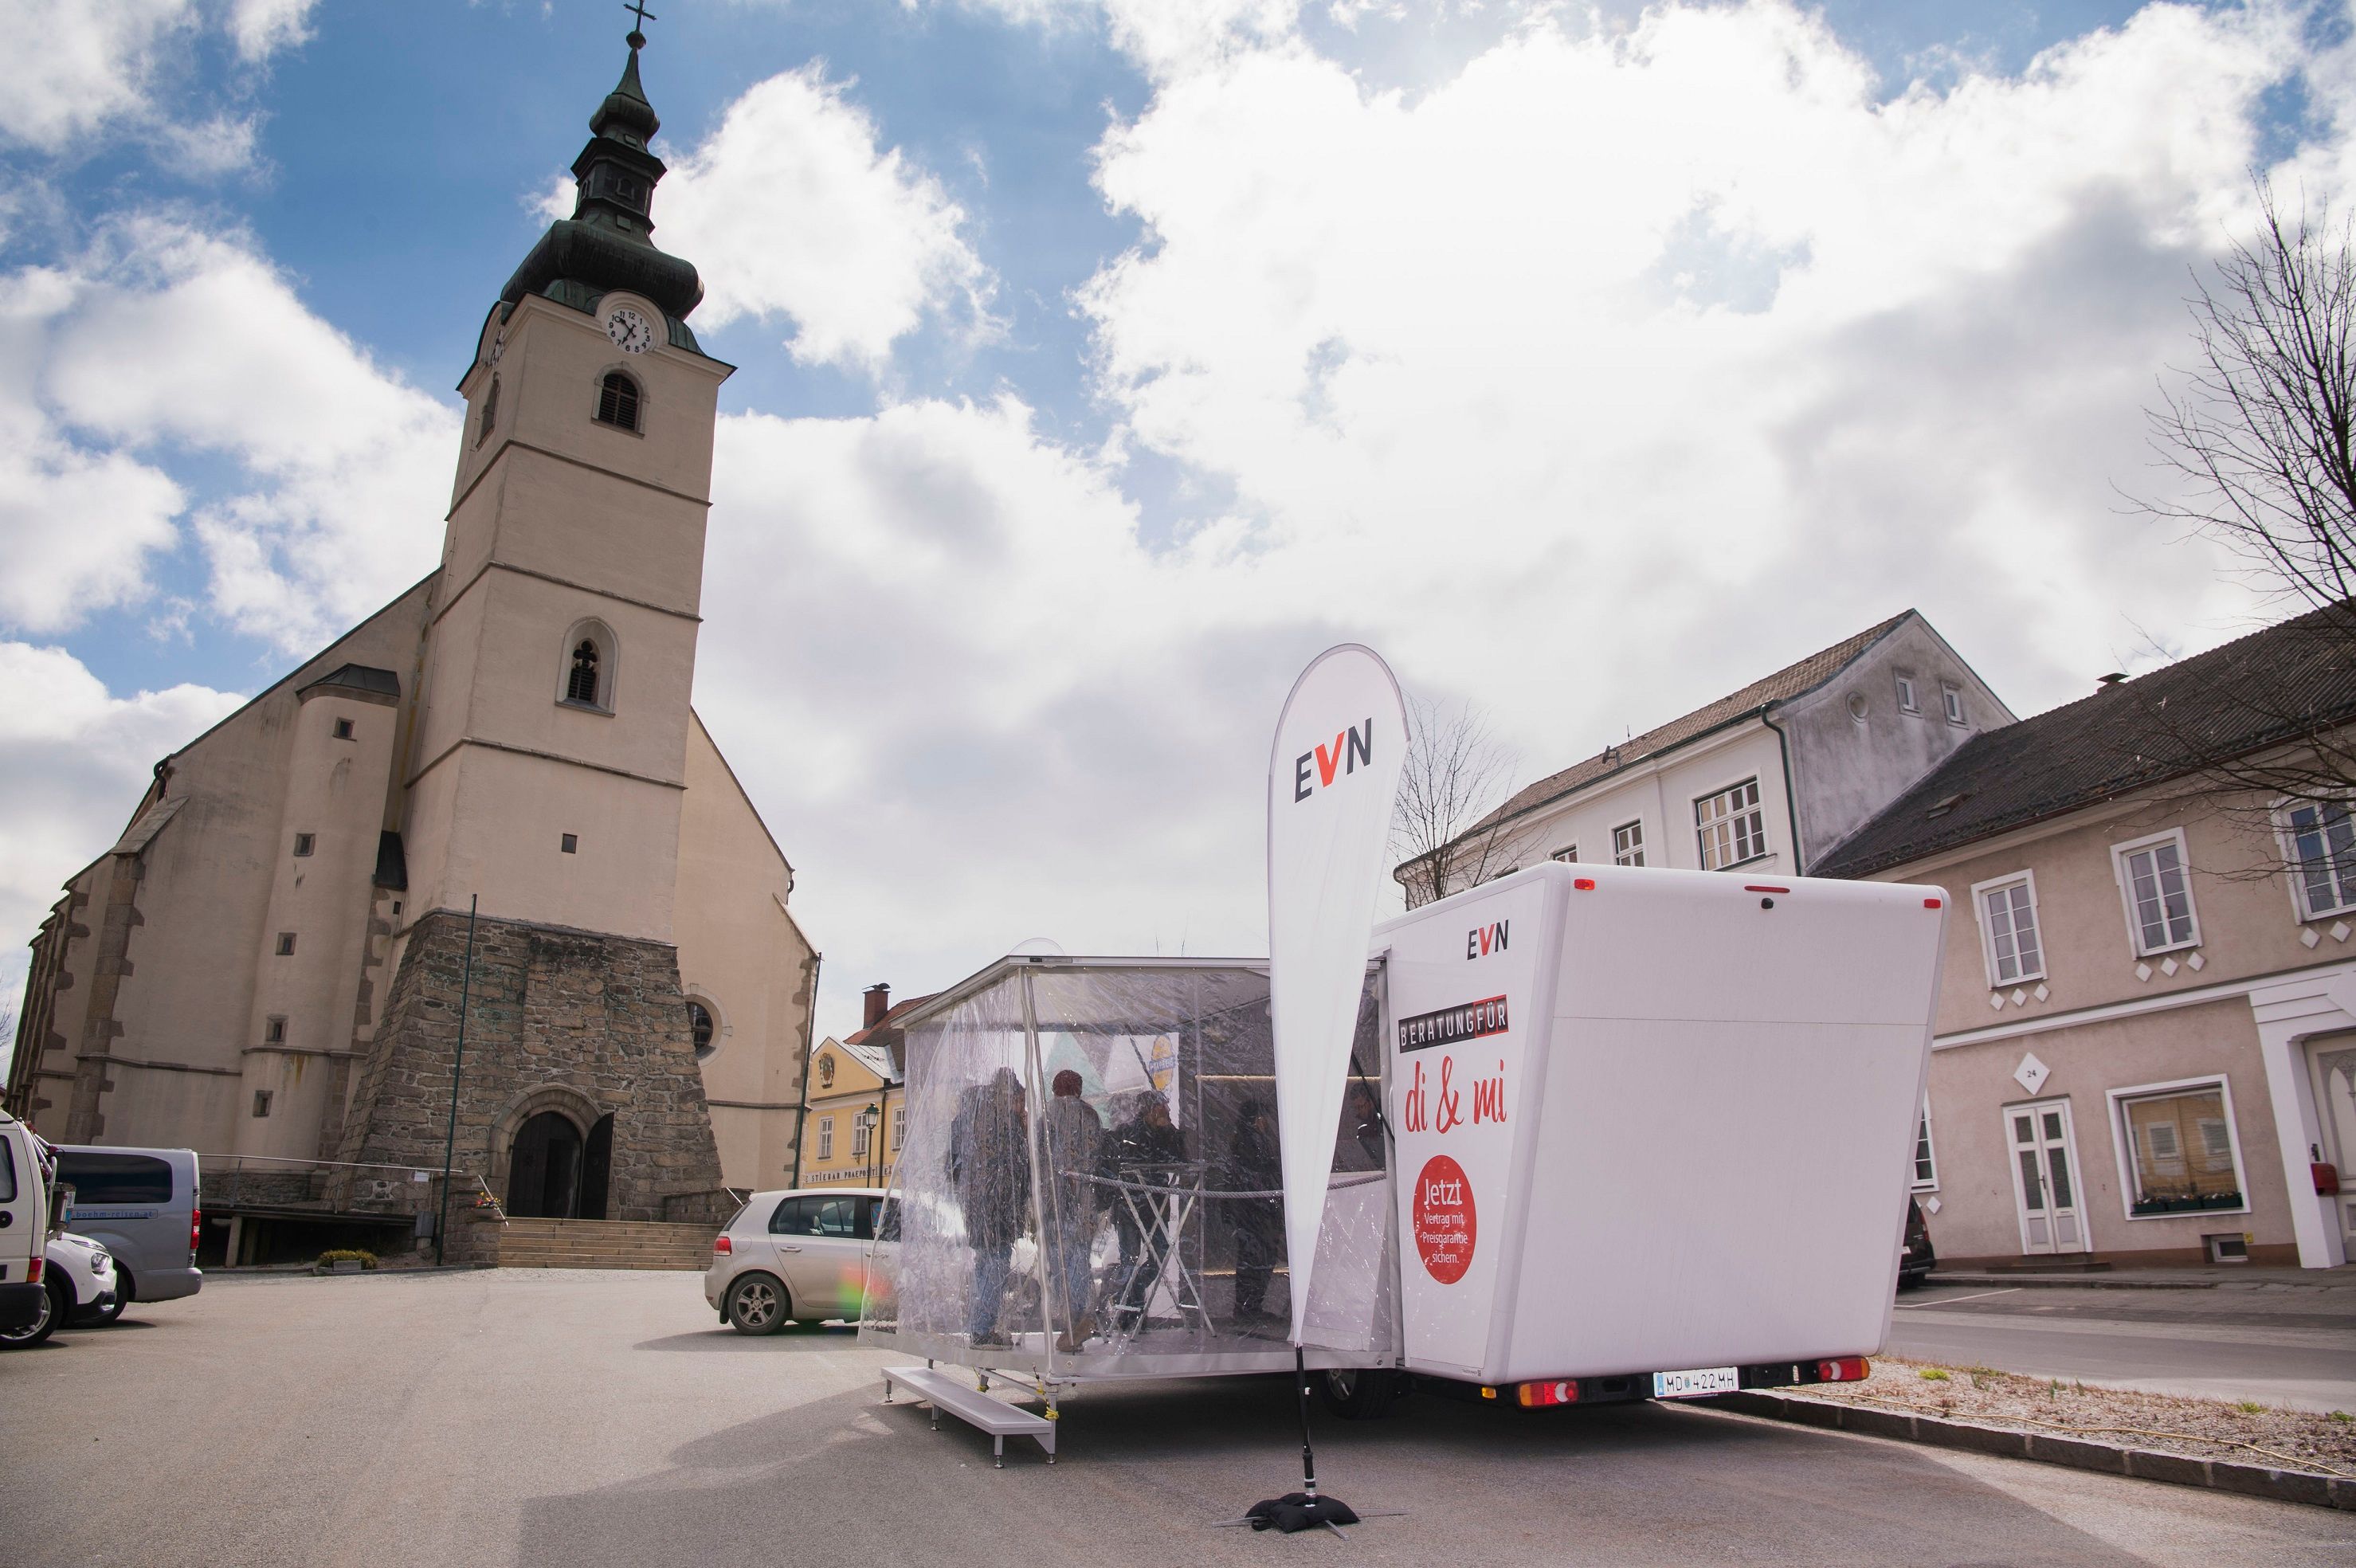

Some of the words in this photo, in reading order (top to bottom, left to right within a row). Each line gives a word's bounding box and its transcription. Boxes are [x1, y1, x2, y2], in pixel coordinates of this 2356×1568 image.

[629, 312, 636, 320] 12
[1295, 717, 1372, 803] EVN
[1467, 919, 1509, 961] EVN
[2027, 1069, 2037, 1078] 24
[1405, 1060, 1428, 1132] di
[1437, 1056, 1464, 1134] &
[1473, 1059, 1507, 1124] mi
[1424, 1178, 1463, 1206] Jetzt
[1424, 1213, 1450, 1228] Vertrag
[1452, 1212, 1464, 1225] mit
[1422, 1231, 1468, 1246] Preisgarantie
[1432, 1251, 1460, 1264] sichern.
[1666, 1376, 1683, 1392] MD
